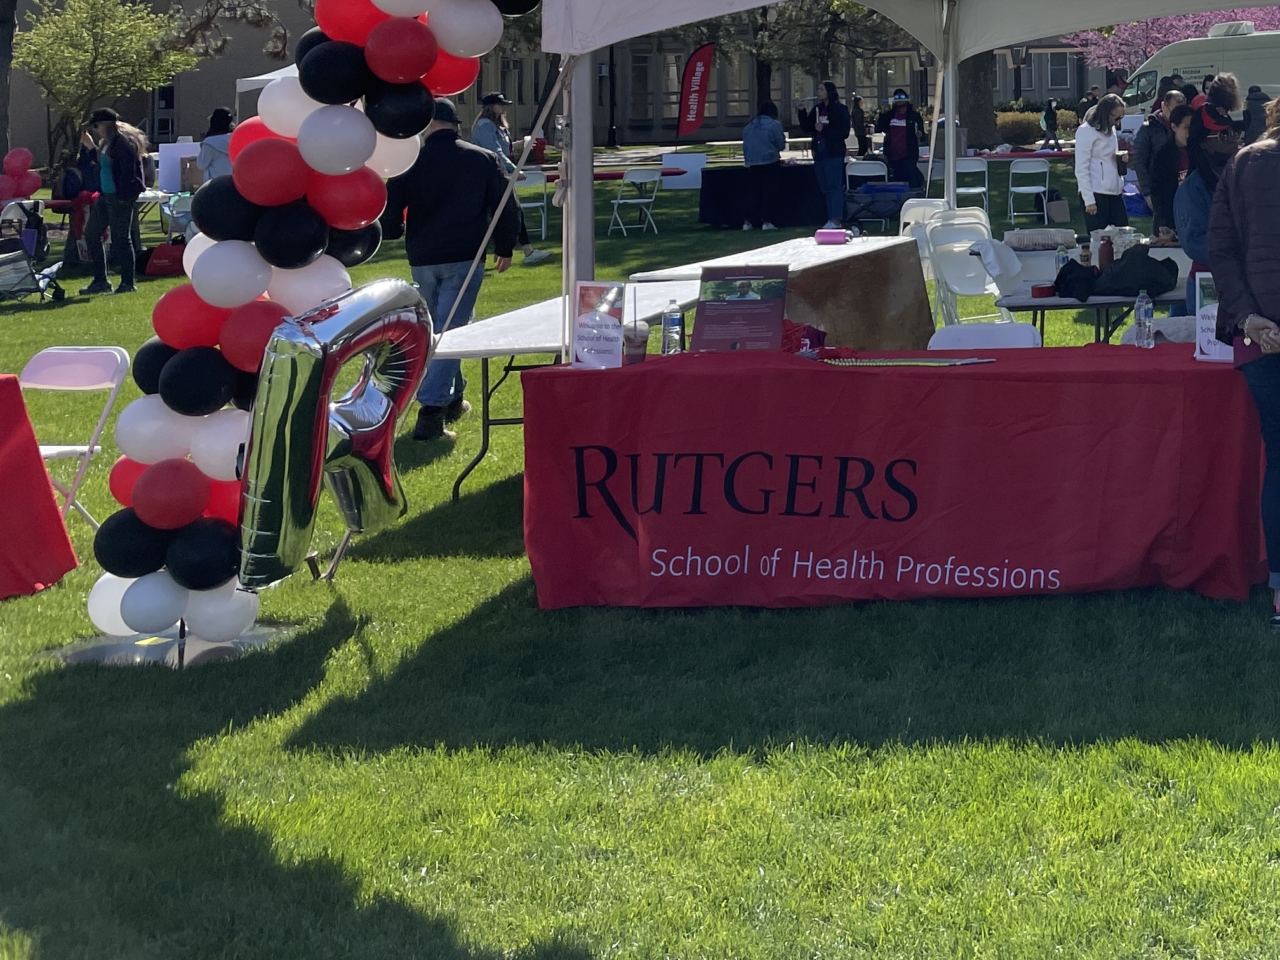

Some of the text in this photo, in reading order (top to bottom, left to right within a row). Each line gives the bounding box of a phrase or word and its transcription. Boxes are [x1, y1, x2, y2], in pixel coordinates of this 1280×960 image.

[687, 62, 704, 121] Health Village
[568, 444, 918, 543] RUTGERS
[650, 544, 1061, 590] School of Health Professions
